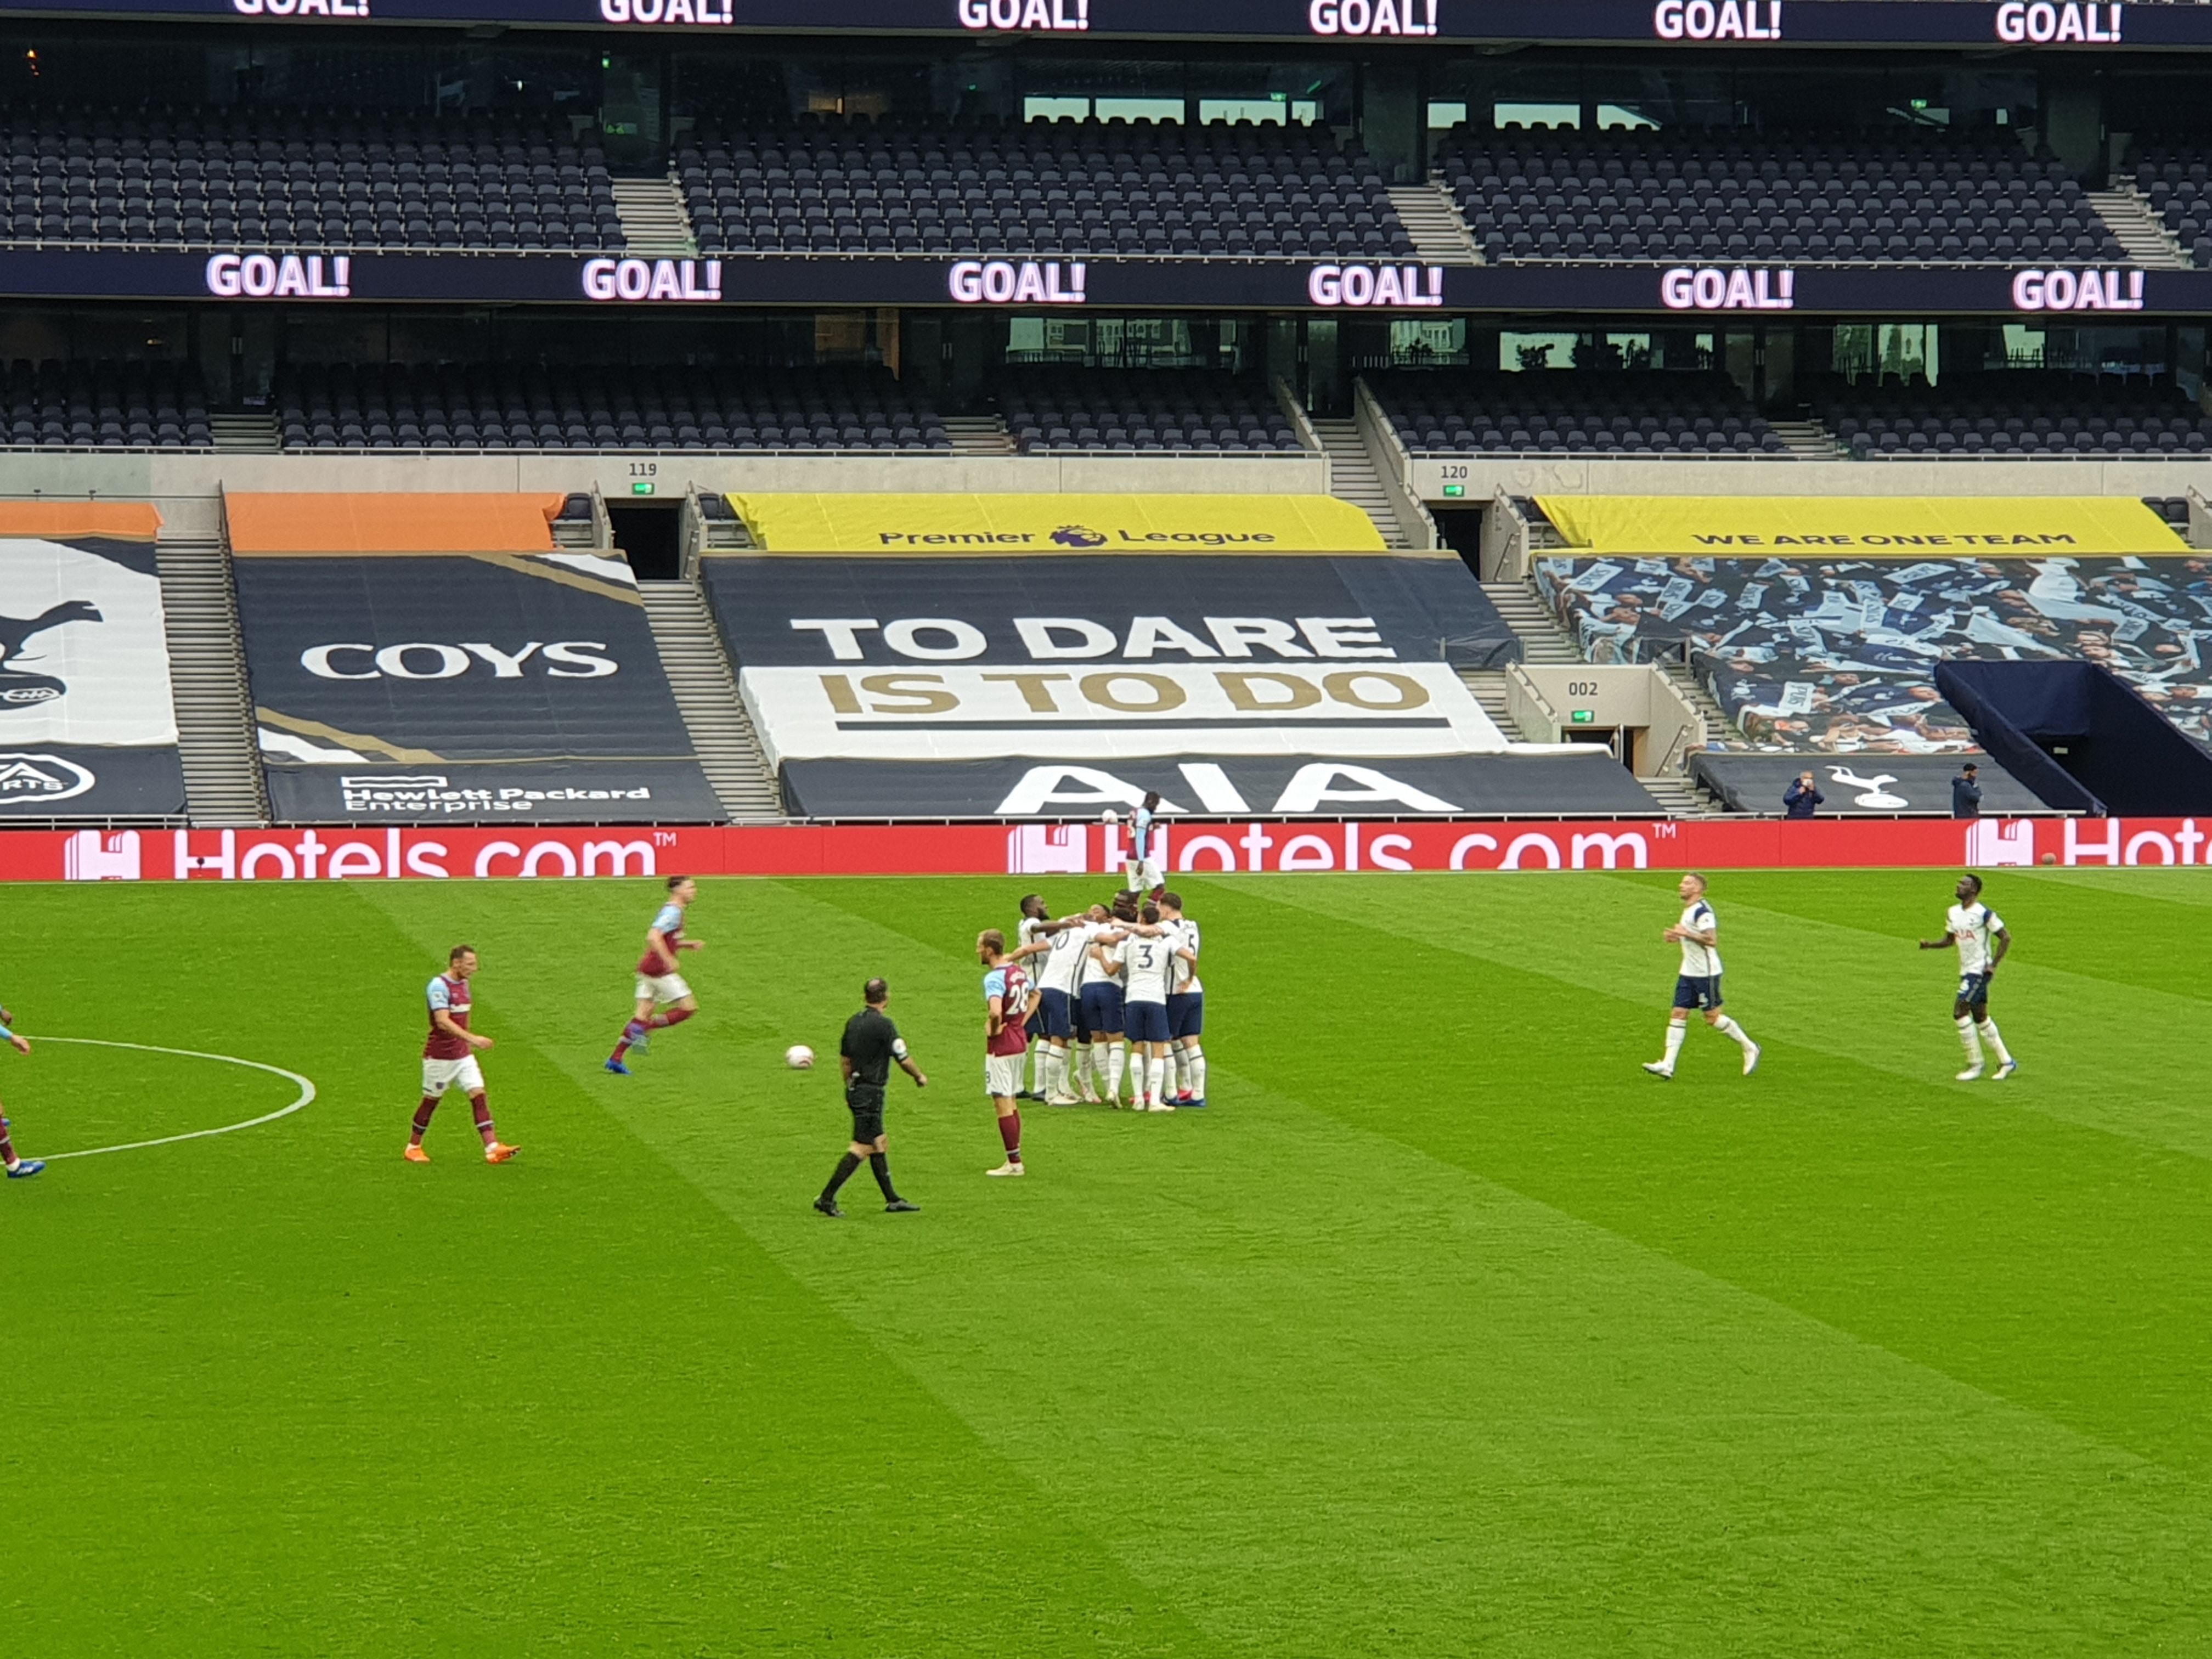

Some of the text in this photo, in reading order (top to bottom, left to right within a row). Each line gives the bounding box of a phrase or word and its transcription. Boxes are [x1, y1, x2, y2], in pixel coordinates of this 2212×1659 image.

[600, 0, 733, 24] GOAL!
[958, 0, 1088, 30] GOAL!
[1310, 0, 1438, 35] GOAL!
[1655, 0, 1782, 39] GOAL!
[1996, 2, 2121, 42] GOAL!
[206, 255, 350, 297] GOAL!
[583, 259, 722, 300] GOAL!
[949, 262, 1086, 302] GOAL!
[1309, 266, 1443, 306] GOAL!
[1661, 269, 1793, 308] GOAL!
[2012, 270, 2145, 309] GOAL!
[629, 463, 657, 476] 119
[1441, 466, 1468, 478] 120
[879, 530, 1276, 545] Premier League
[1693, 534, 2076, 545] WE ARE ONE TEAM
[790, 616, 1397, 660] TO DARE
[301, 642, 618, 679] COYS
[819, 671, 1430, 714] IS TO DO
[1568, 682, 1598, 696] 002
[2, 779, 64, 791] RTS
[343, 787, 651, 800] Hewlett Packard
[994, 763, 1464, 814] AIA
[345, 800, 534, 813] Enterprise
[2064, 817, 2212, 866] Hot
[1138, 944, 1154, 969] 3
[1006, 981, 1029, 1014] 28
